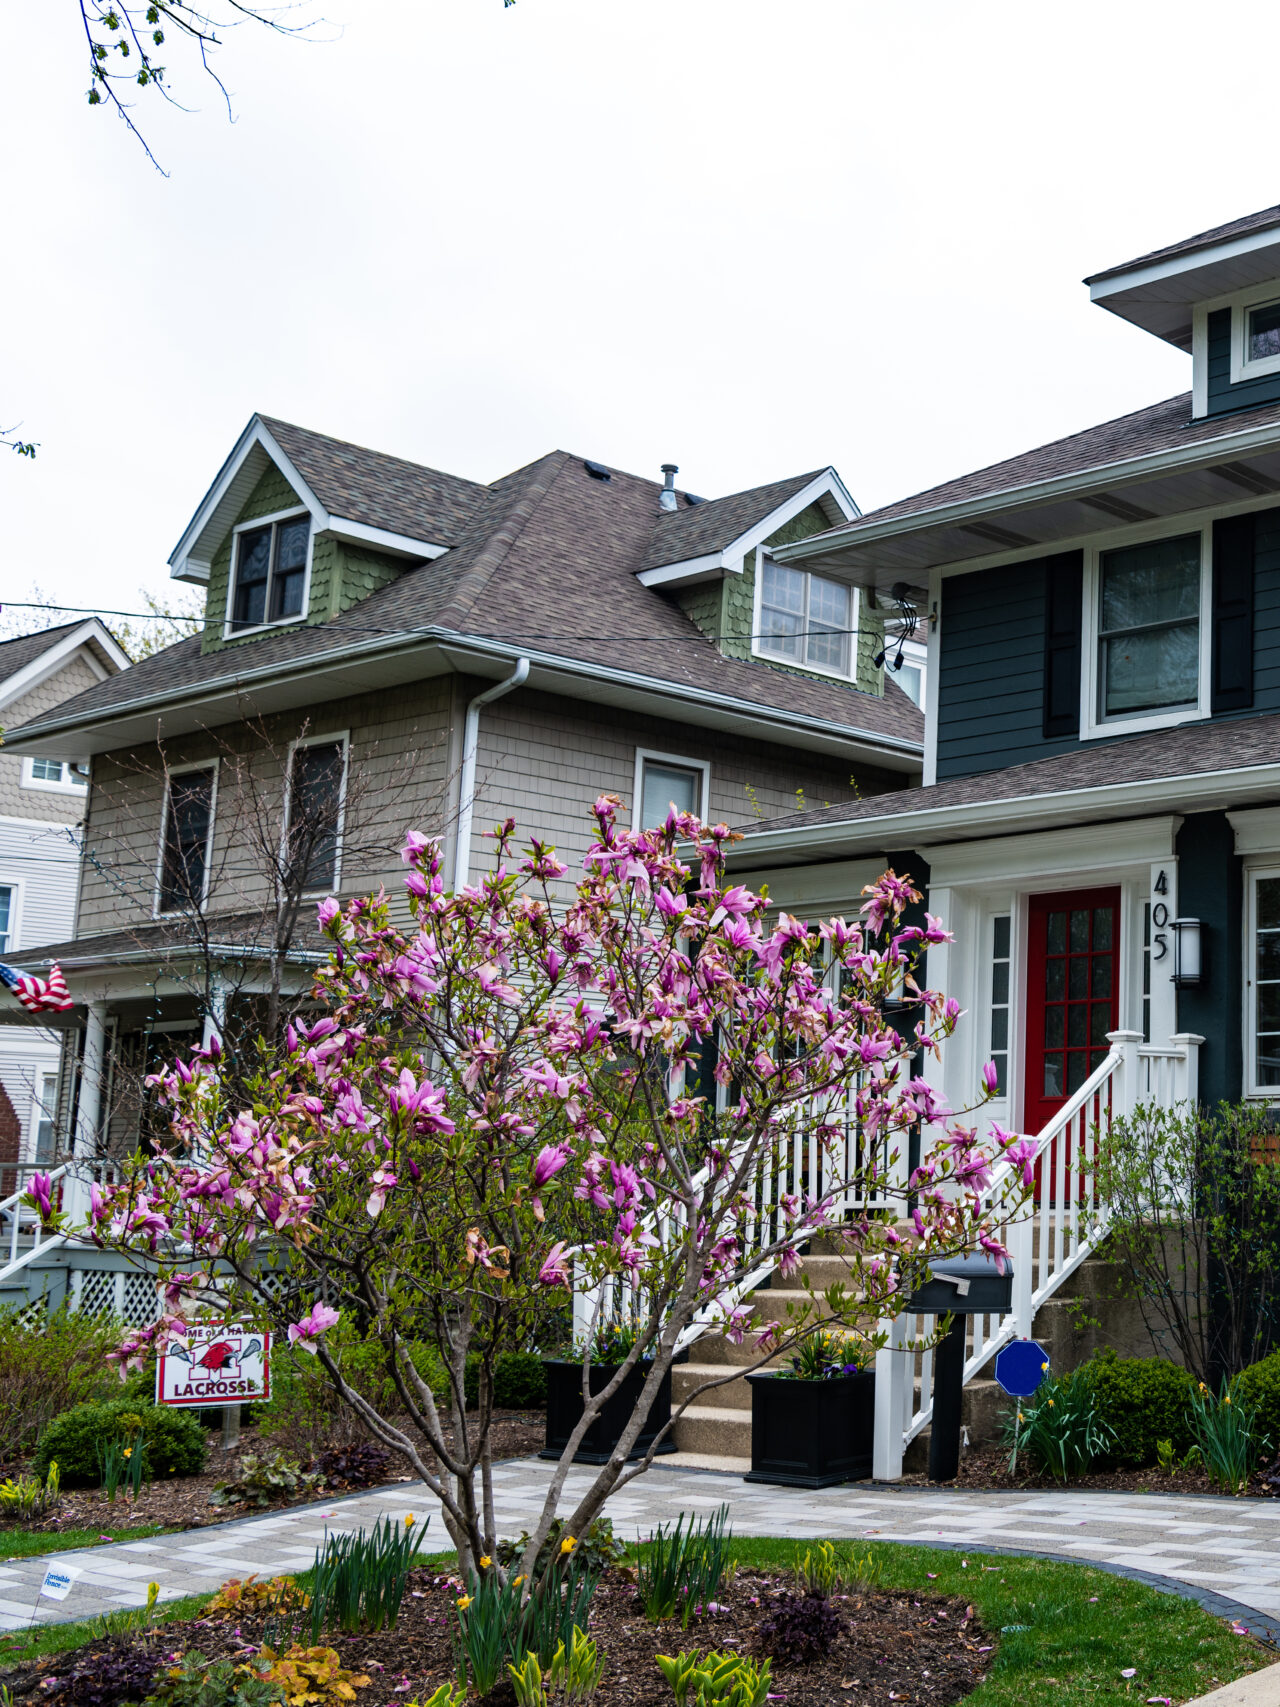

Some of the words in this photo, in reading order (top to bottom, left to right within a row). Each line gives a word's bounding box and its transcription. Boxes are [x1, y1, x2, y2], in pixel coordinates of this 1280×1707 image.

[1152, 870, 1168, 960] 405
[183, 1329, 203, 1338] OME
[174, 1381, 255, 1397] LACROSSE
